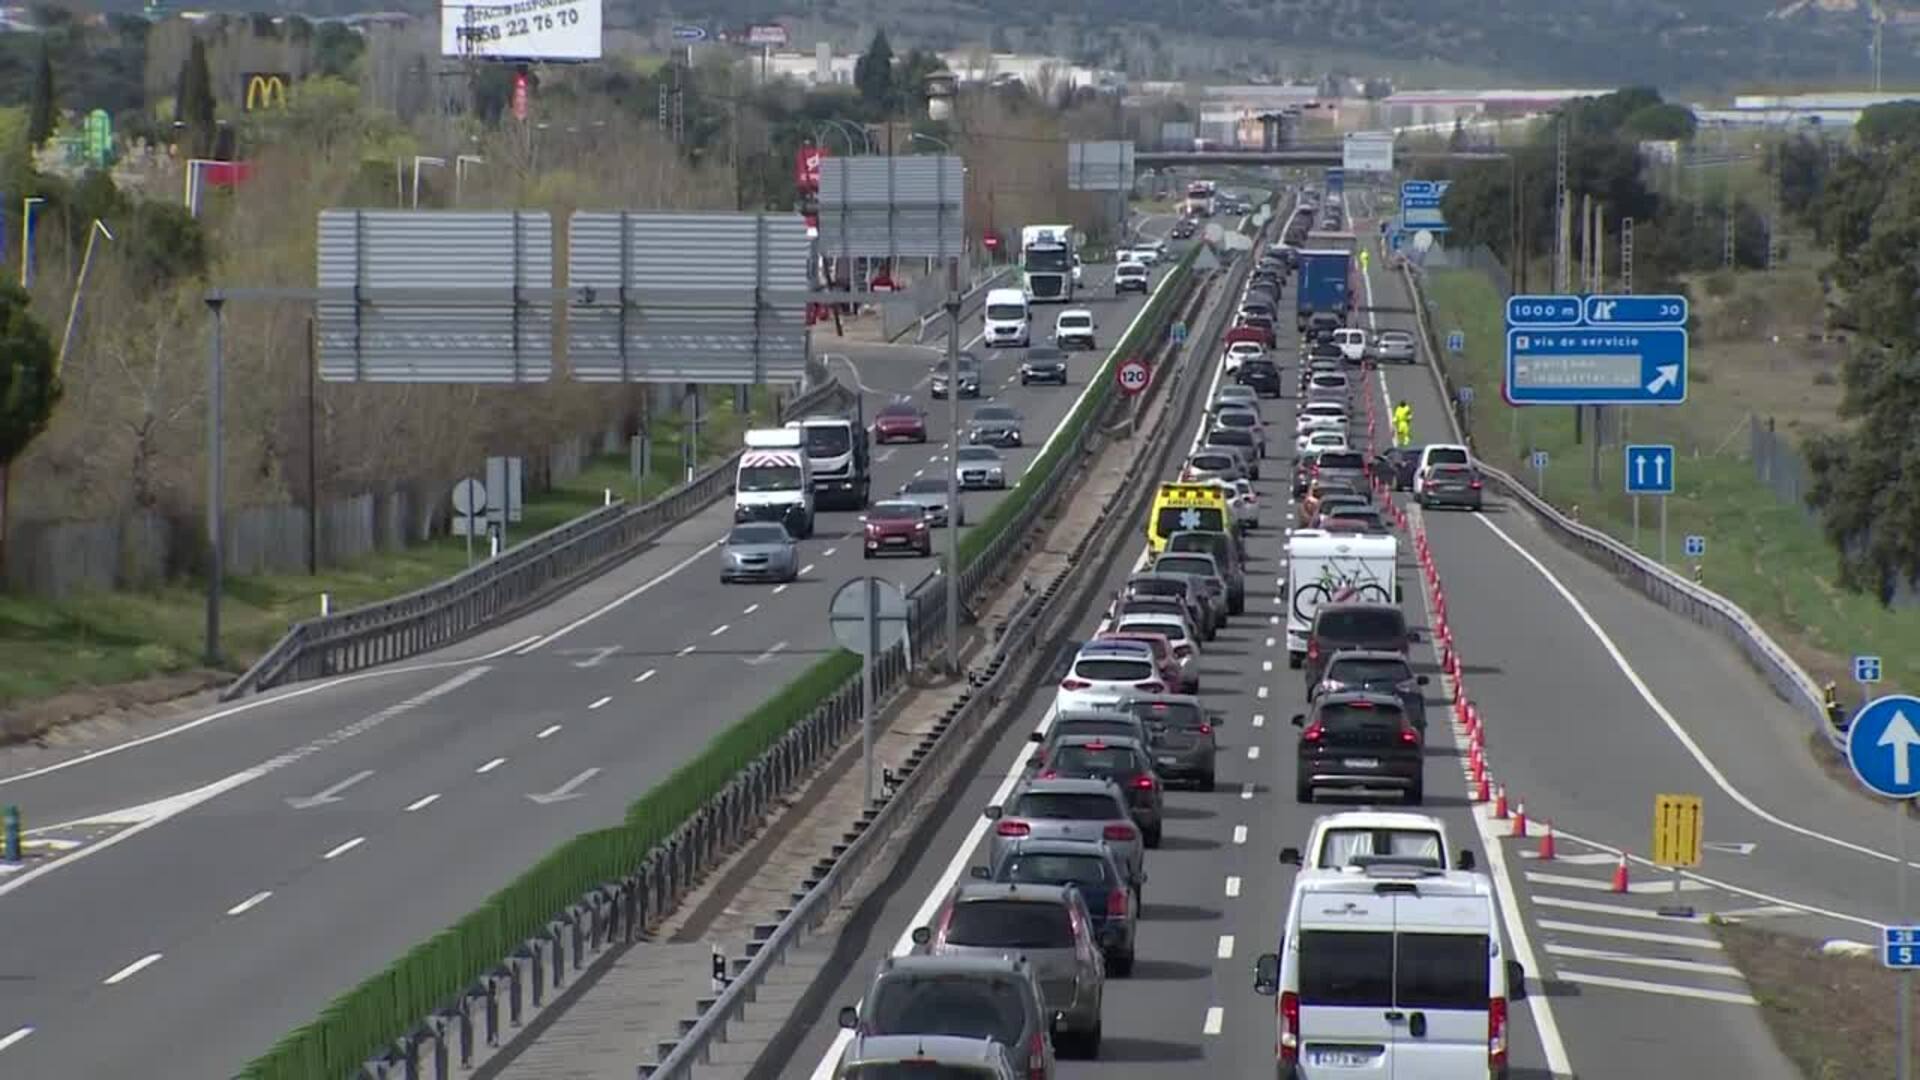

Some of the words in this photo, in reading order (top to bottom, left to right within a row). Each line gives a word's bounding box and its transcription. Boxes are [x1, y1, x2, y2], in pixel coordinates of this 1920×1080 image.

[505, 17, 530, 37] 22
[533, 12, 553, 31] 76
[556, 7, 579, 27] 70
[1514, 305, 1556, 317] 1000
[1561, 306, 1575, 317] m
[1560, 336, 1575, 348] de
[1581, 335, 1639, 348] servicio
[1122, 371, 1145, 383] 120
[1899, 947, 1912, 964] 5
